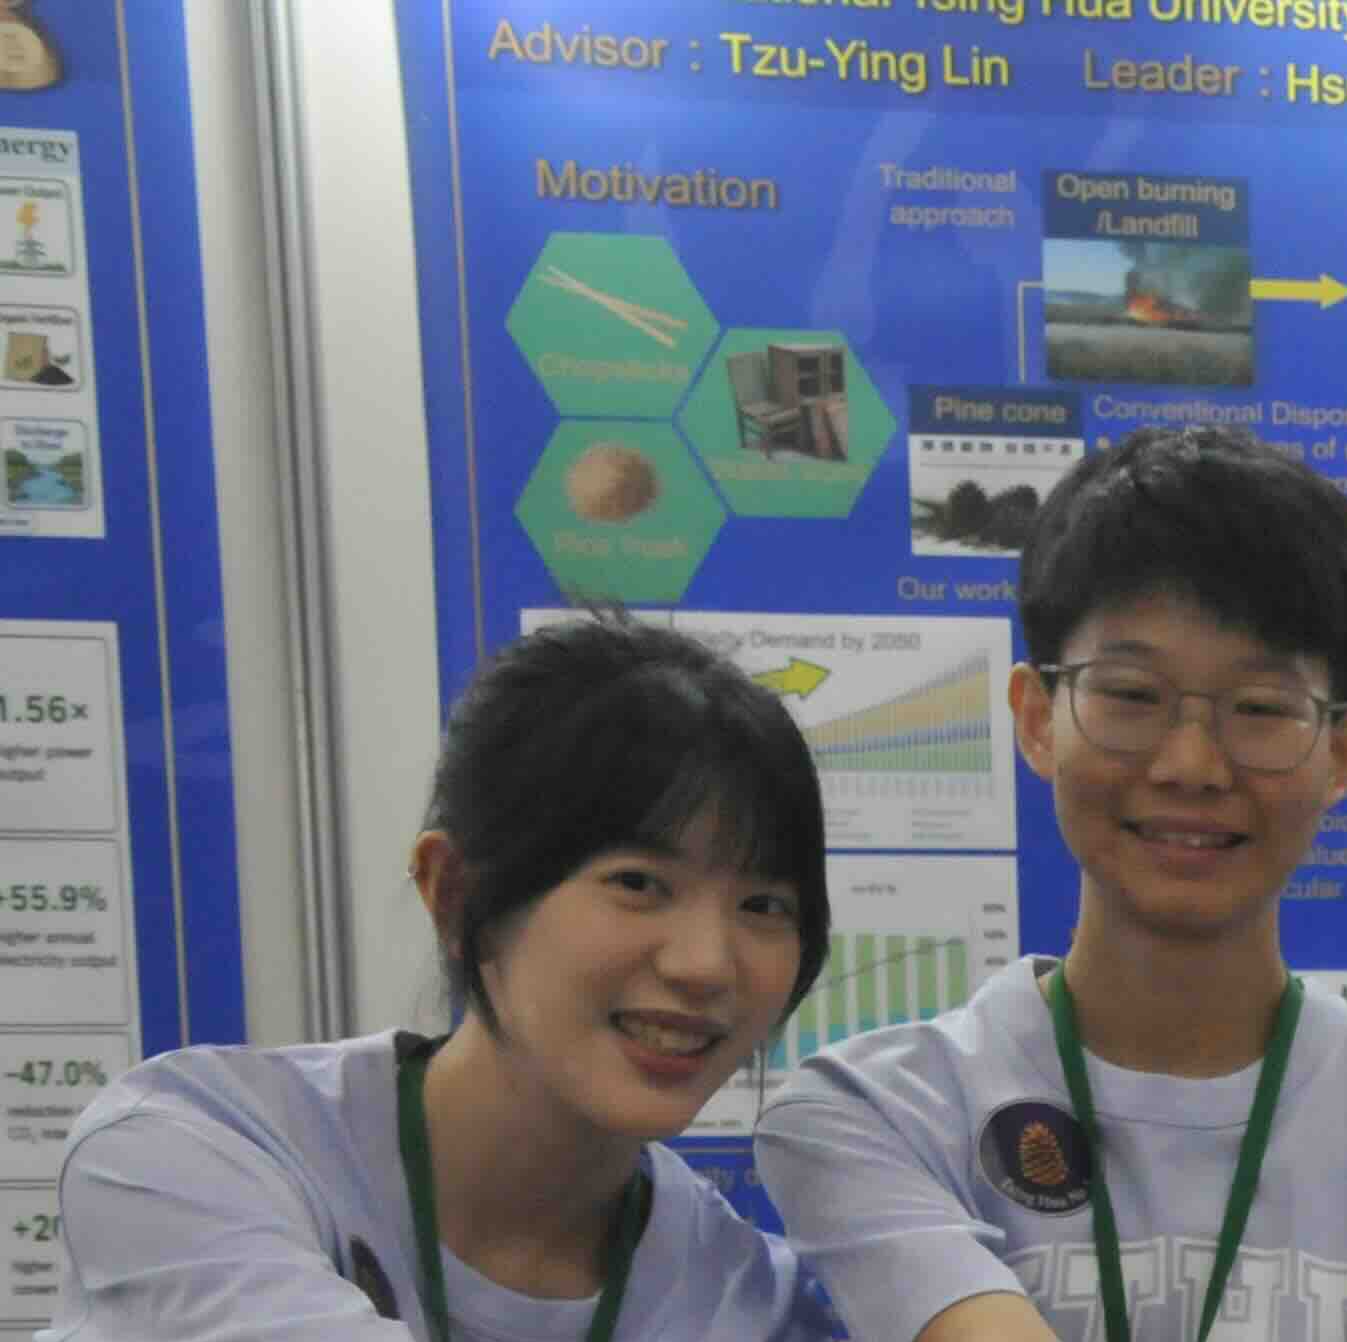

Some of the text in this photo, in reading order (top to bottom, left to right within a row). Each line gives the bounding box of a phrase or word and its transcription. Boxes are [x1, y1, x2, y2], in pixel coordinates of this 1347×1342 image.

[488, 20, 668, 69] Advisor
[720, 32, 927, 94] Tzu-Ying
[943, 44, 1010, 88] Lin
[1083, 48, 1240, 96] Leader
[534, 158, 779, 210] Motivation
[879, 164, 1017, 195] Traditional
[1056, 174, 1237, 210] Open burning
[888, 204, 1015, 230] approach
[1096, 210, 1199, 239] /Landfill
[936, 397, 1067, 424] Pine cone
[1092, 394, 1264, 425] Conventional
[1313, 439, 1337, 460] of
[896, 577, 1017, 603] Our work
[750, 632, 837, 651] Demand
[841, 634, 865, 653] by
